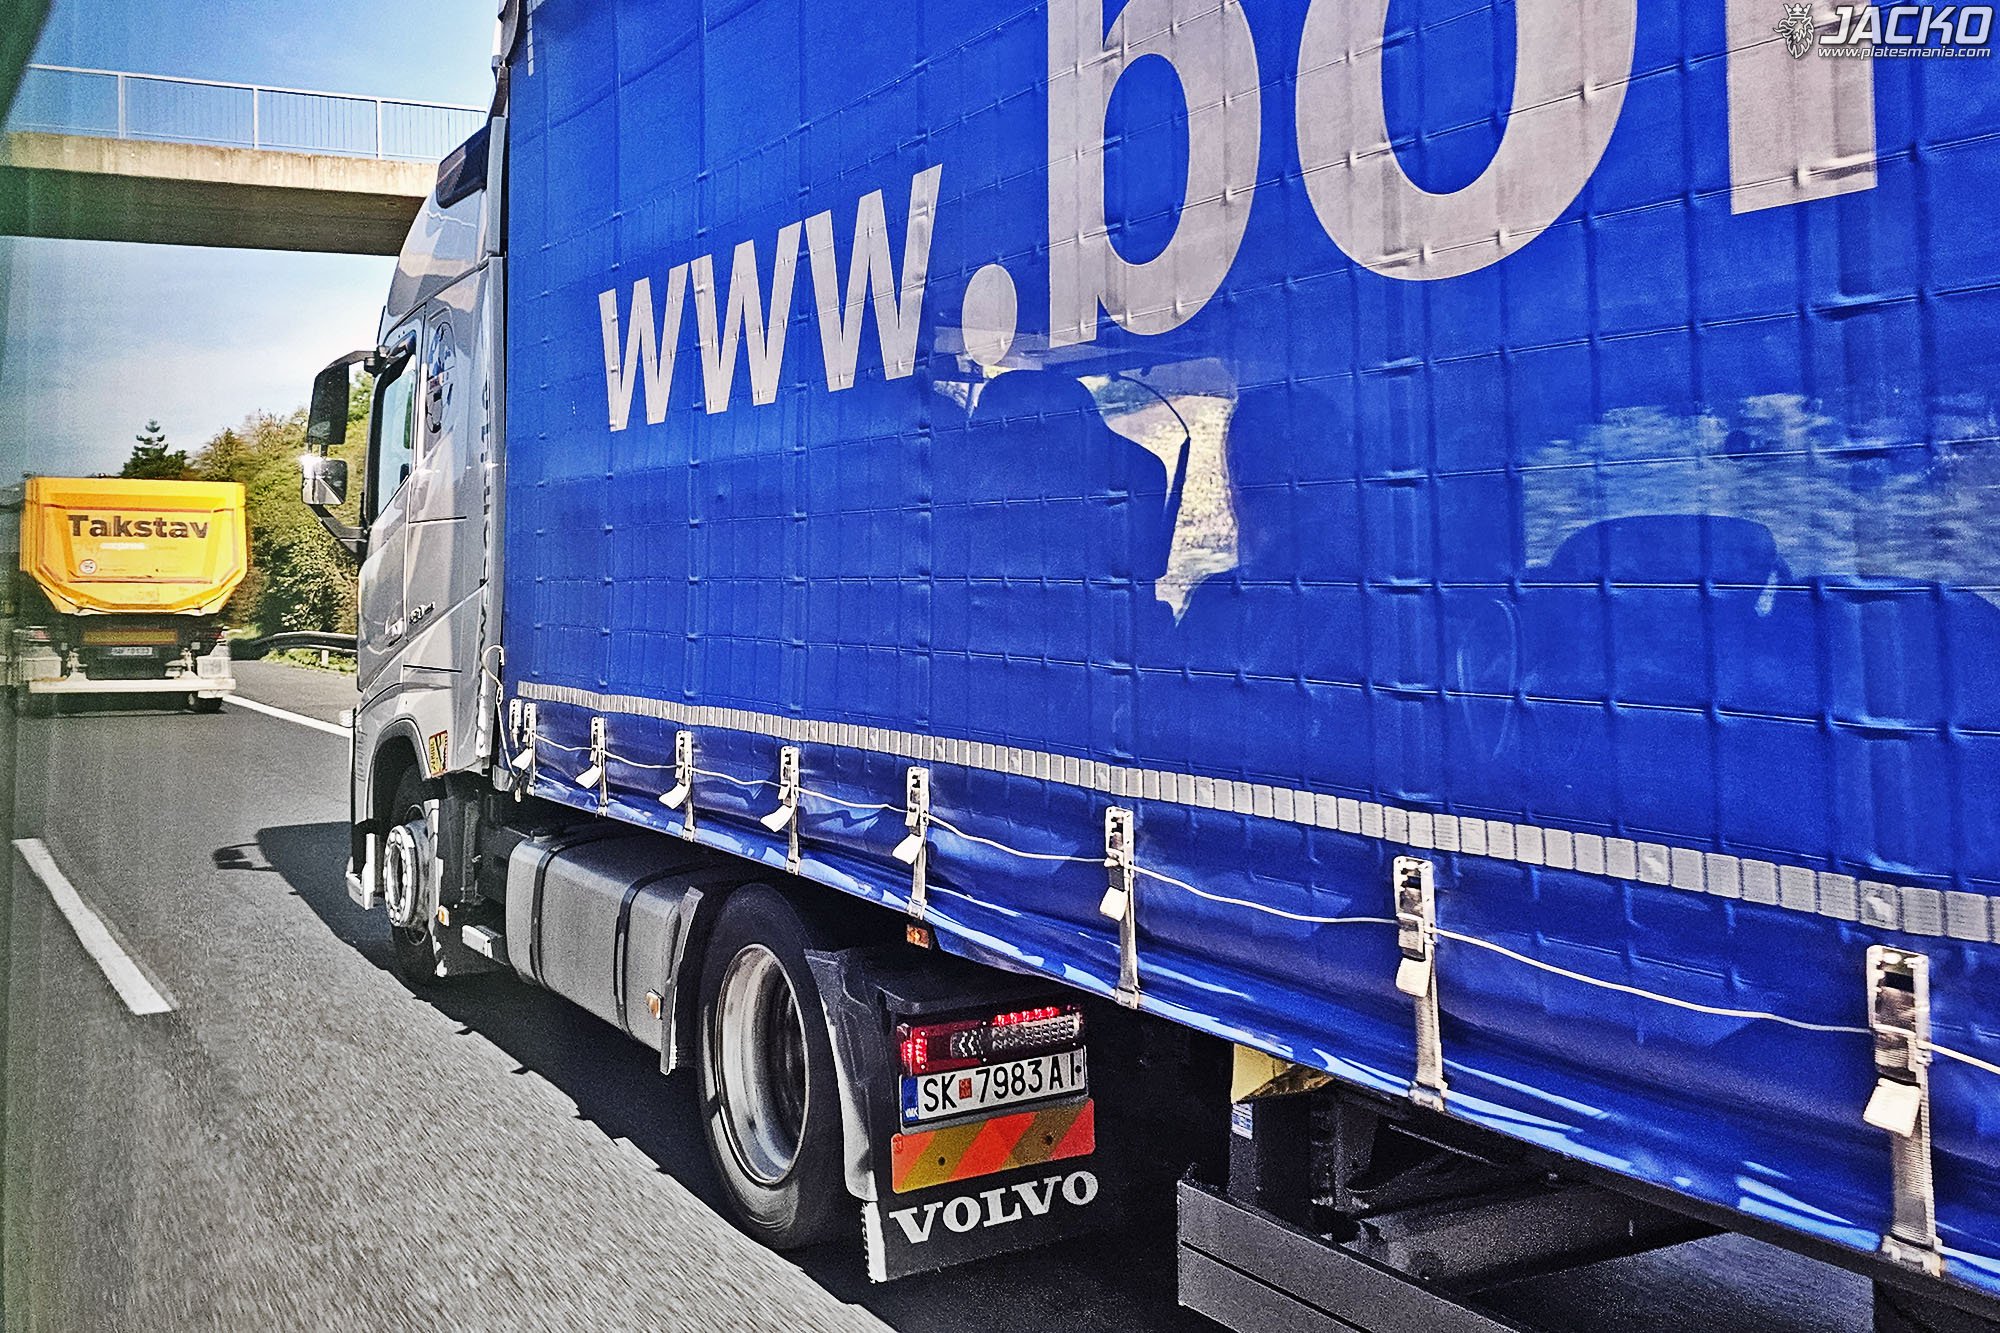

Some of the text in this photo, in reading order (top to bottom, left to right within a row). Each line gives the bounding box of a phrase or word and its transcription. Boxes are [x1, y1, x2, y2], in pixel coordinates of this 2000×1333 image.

[68, 514, 208, 538] Takstav
[923, 1074, 957, 1112] SK
[976, 1059, 1043, 1103] 7983
[889, 1171, 1099, 1244] VOLVO
